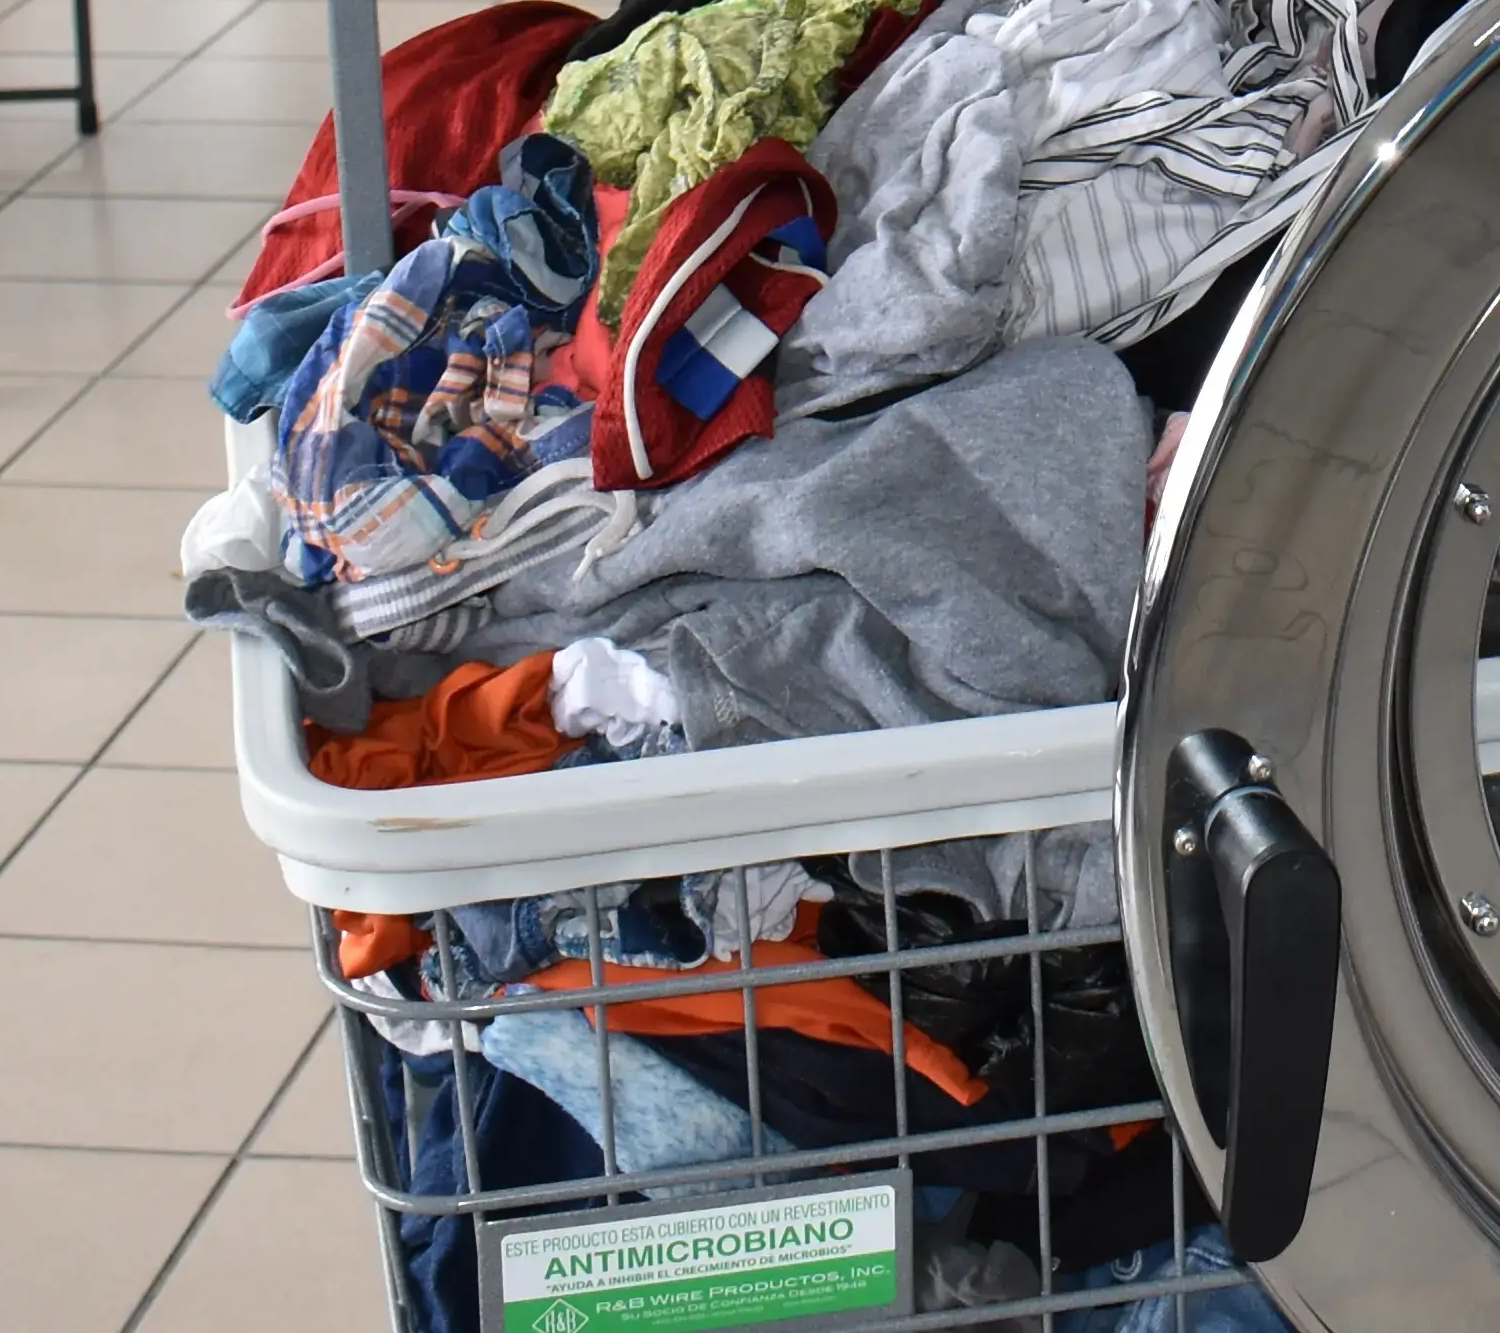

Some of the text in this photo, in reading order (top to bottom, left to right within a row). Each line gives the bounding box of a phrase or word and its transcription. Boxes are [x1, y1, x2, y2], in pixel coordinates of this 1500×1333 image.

[505, 1193, 890, 1258] ESTE PRODUCTO ESTA CUBIERTO CON UN REVESTIMIENTO
[545, 1218, 854, 1280] ANTIMICROBIANO
[596, 1278, 606, 1287] A
[609, 1273, 655, 1286] INHIBIR
[658, 1270, 673, 1279] EL
[675, 1258, 757, 1277] CRECIMIENTO
[759, 1255, 776, 1265] DE
[596, 1264, 891, 1314] R&B WIRE PRODUCTOS, INC.
[710, 1294, 785, 1309] CONFIANZA
